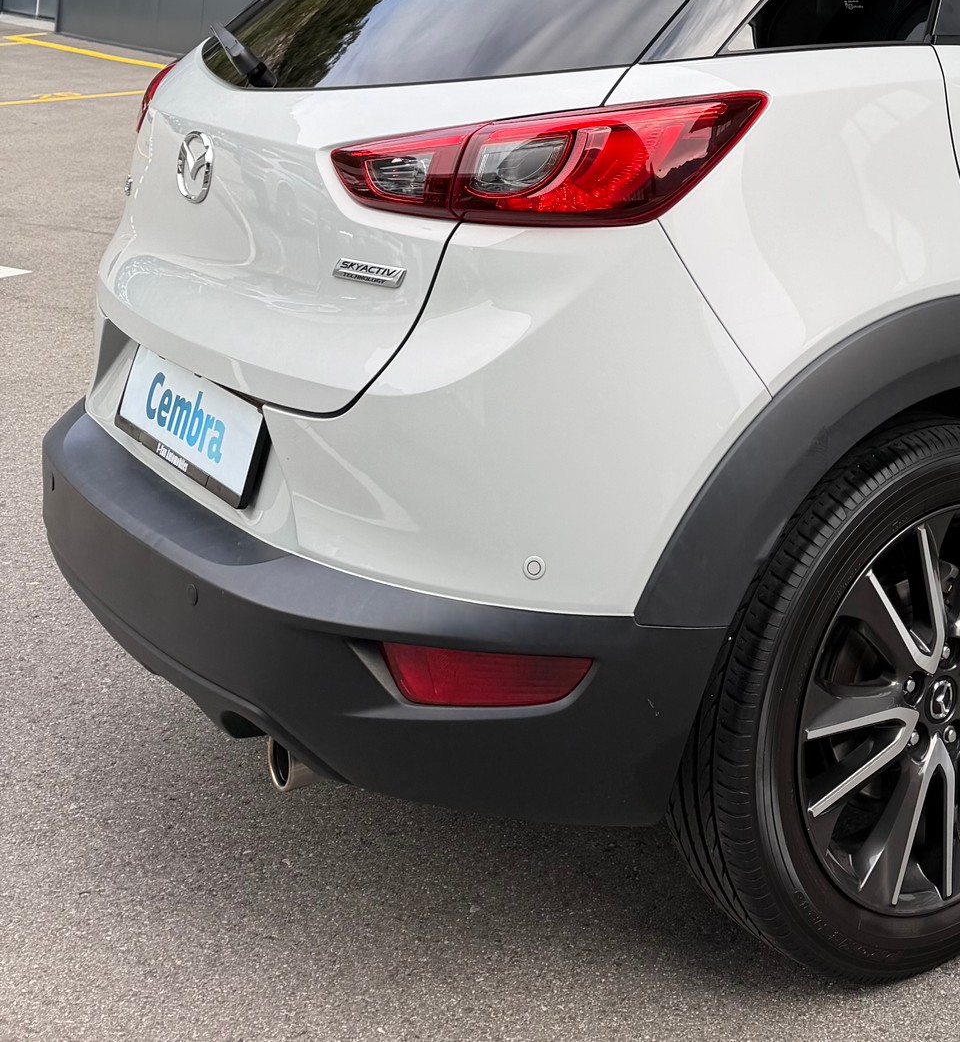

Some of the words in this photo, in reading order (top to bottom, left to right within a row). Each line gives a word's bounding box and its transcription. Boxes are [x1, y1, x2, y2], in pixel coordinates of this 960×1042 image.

[340, 260, 397, 277] SKYACTIV
[342, 271, 387, 284] TECHNOLOGY
[145, 371, 226, 464] Cembra
